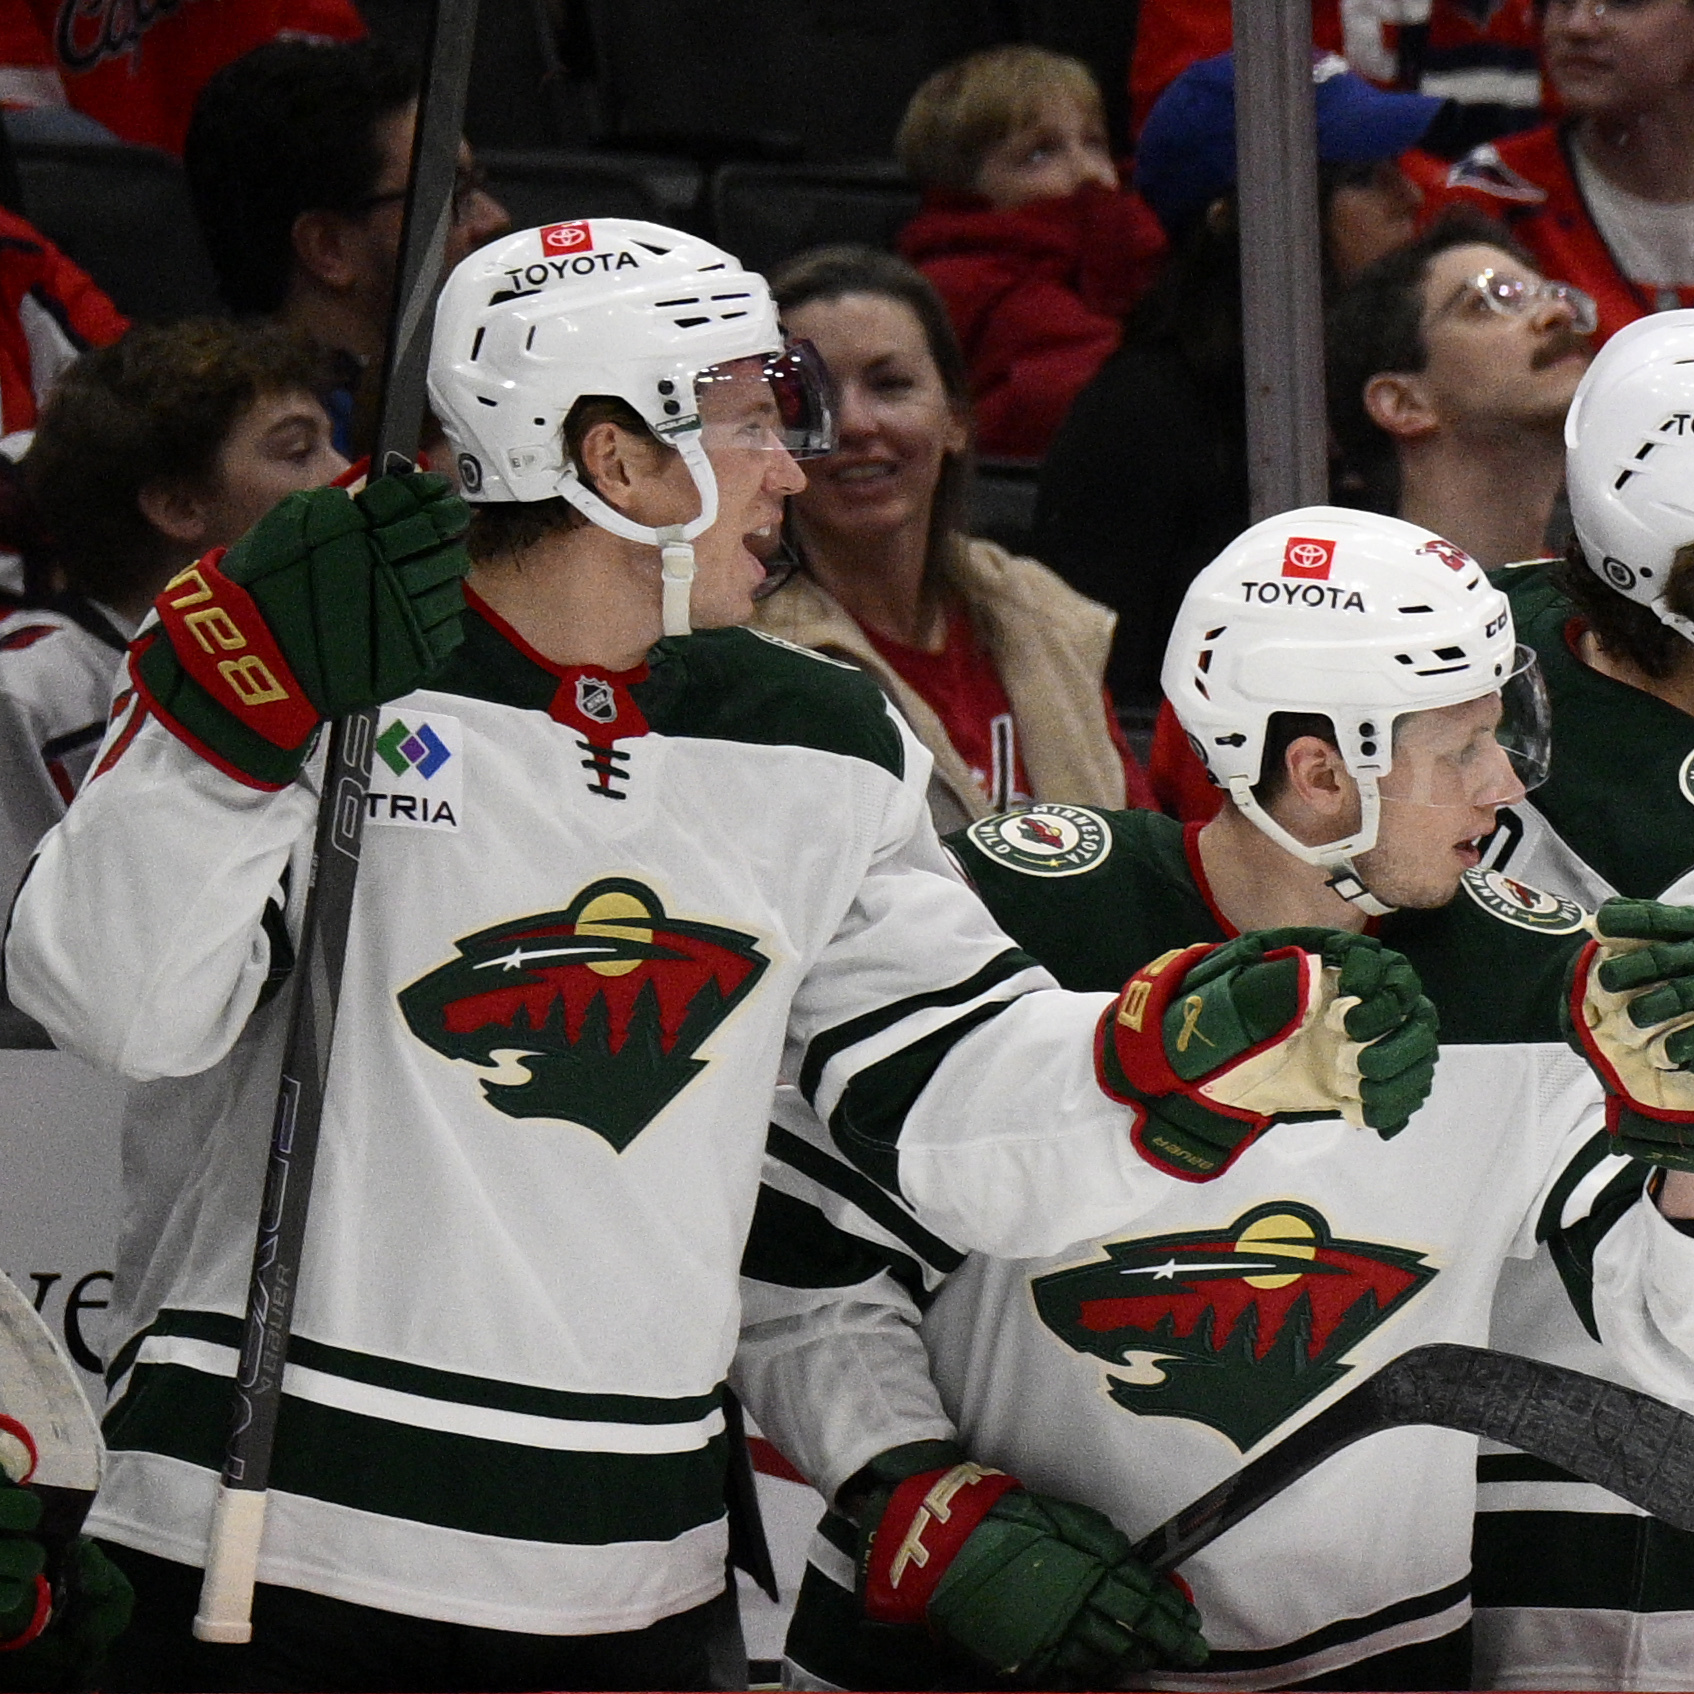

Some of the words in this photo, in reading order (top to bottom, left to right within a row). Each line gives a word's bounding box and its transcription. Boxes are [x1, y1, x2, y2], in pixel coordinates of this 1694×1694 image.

[504, 251, 639, 291] TOYOTA
[1241, 582, 1366, 613] TOYOTA
[364, 793, 457, 826] TRIA
[978, 825, 1011, 854] WILD
[1032, 805, 1101, 864] MINNESOTA
